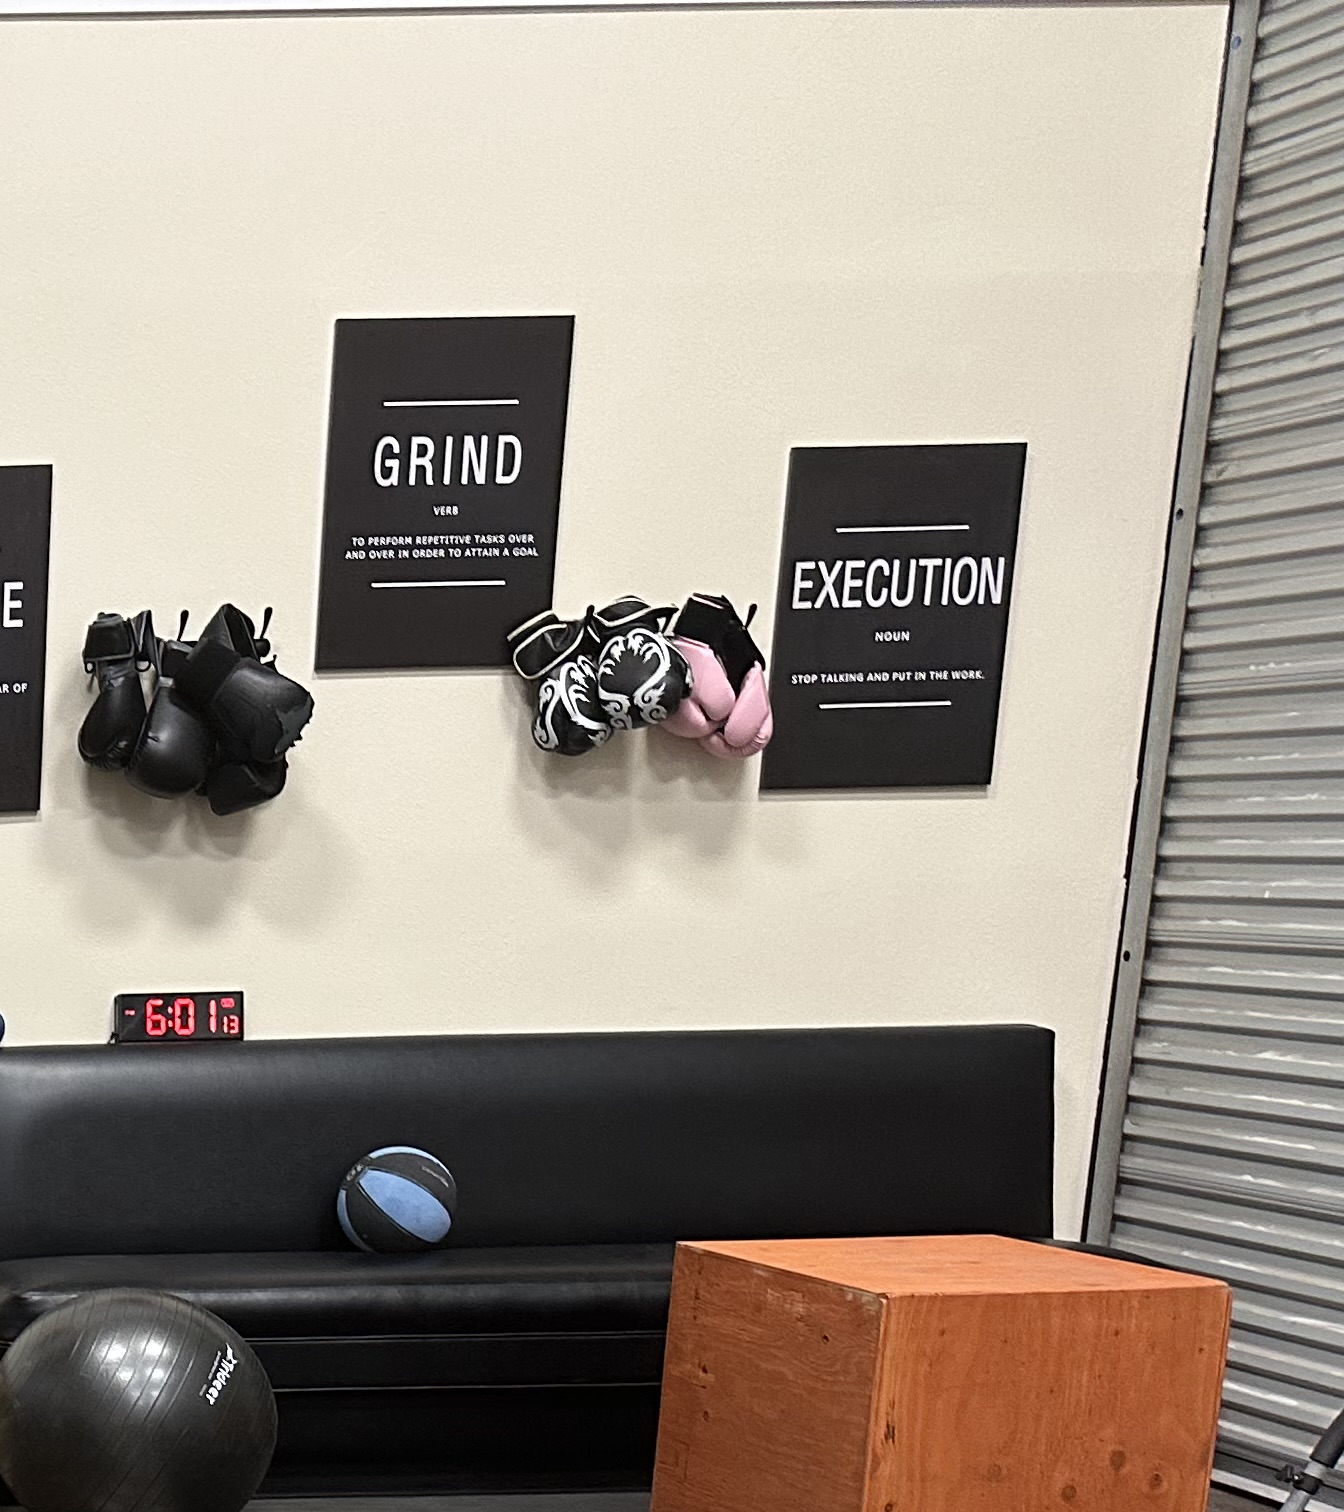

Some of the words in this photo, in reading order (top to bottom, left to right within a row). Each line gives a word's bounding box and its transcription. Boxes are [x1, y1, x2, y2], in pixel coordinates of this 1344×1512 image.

[373, 434, 523, 487] GRIND
[433, 505, 459, 516] VERB
[351, 537, 365, 547] TO
[367, 536, 412, 546] PERFORM
[415, 535, 471, 545] REPETITIVE
[473, 534, 505, 544] TASKS
[508, 533, 534, 543] OVER
[344, 551, 366, 560] AND
[368, 550, 395, 559] OVER
[398, 549, 409, 559] IN
[412, 548, 445, 558] ORDER
[447, 548, 461, 557] TO
[464, 547, 500, 557] ATTAIN
[502, 547, 510, 557] A
[512, 547, 539, 557] GOAL
[791, 556, 1006, 610] EXECUTION
[874, 630, 910, 643] NOUN
[791, 674, 818, 685] STOP
[820, 672, 864, 684] TALKING
[866, 672, 890, 682] AND
[892, 671, 912, 682] PUT
[914, 671, 927, 681] IN
[929, 670, 949, 681] THE
[951, 669, 985, 680] WORK.
[13, 682, 28, 693] OF
[145, 997, 218, 1036] 6:01
